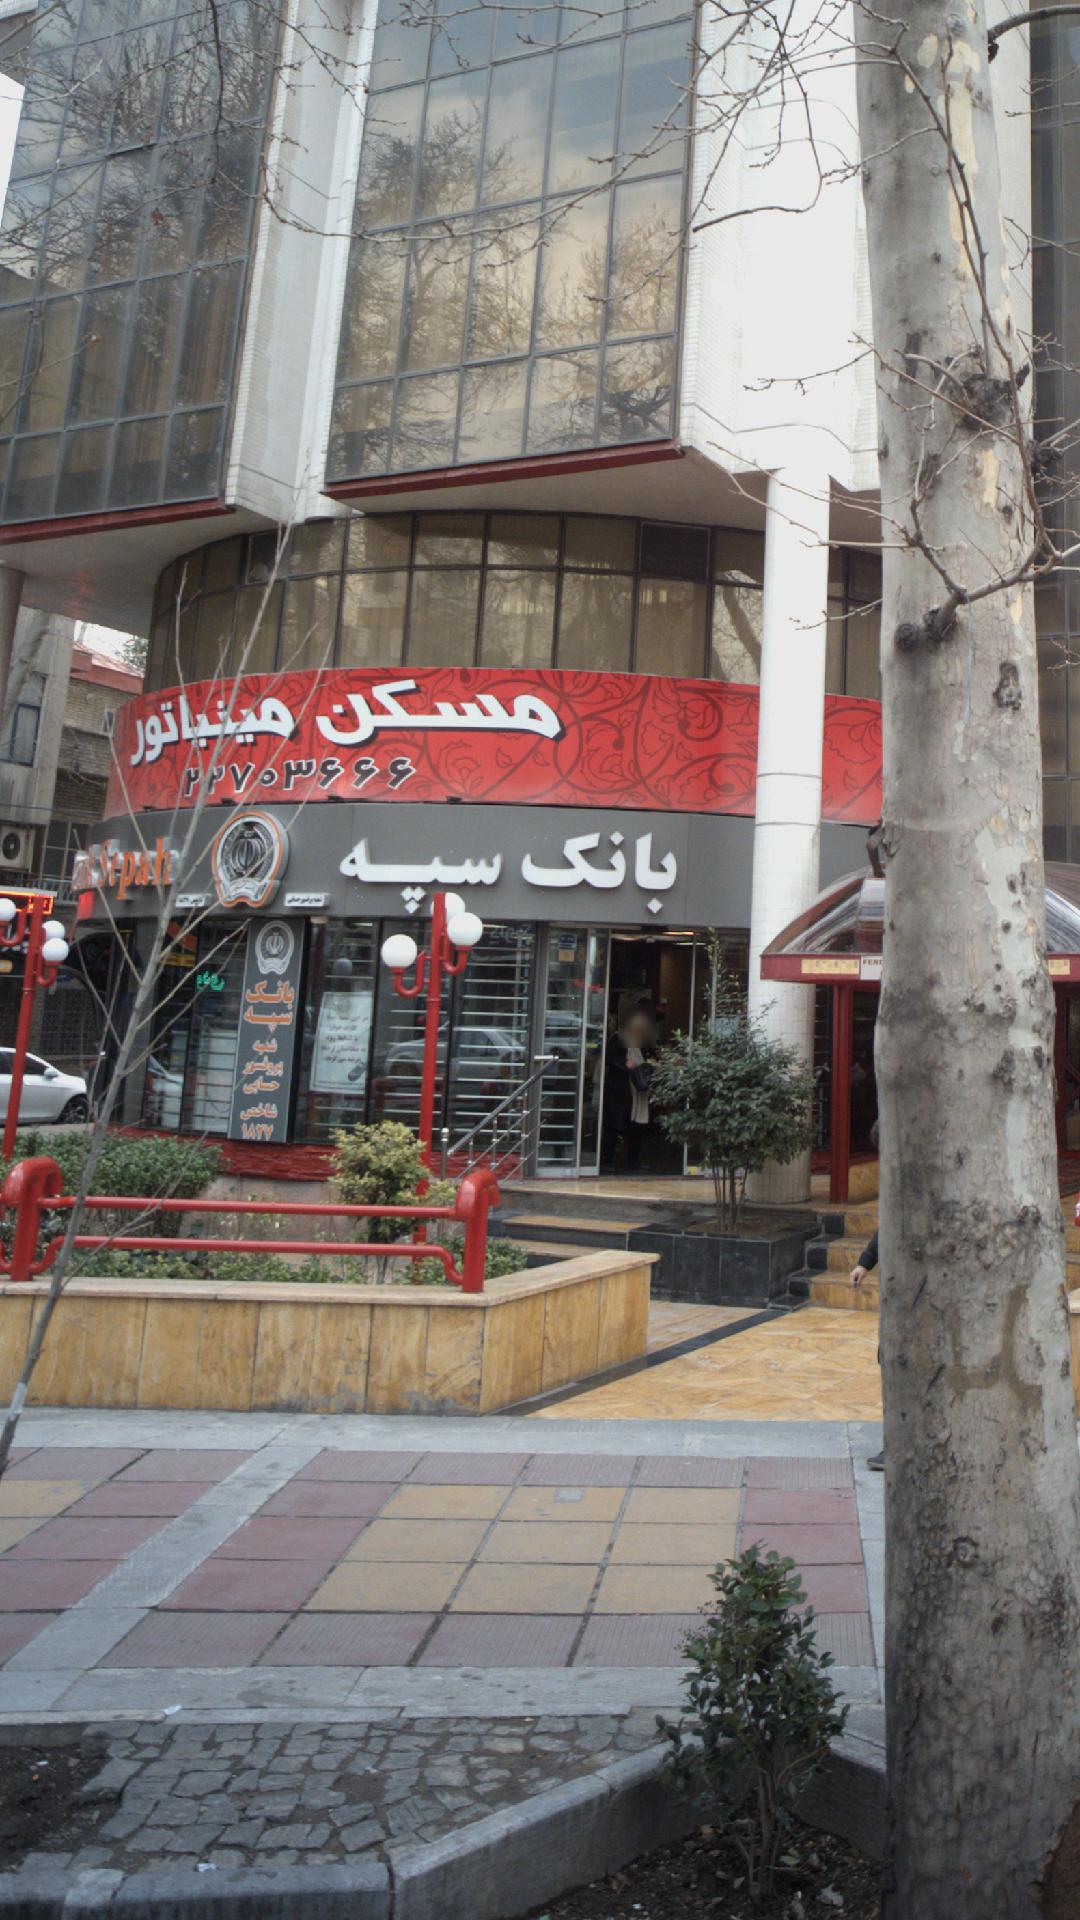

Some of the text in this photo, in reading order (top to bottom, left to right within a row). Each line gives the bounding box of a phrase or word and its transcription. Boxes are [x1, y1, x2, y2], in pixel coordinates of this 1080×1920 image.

[130, 679, 563, 767] مسکن مینیاتور
[96, 836, 174, 901] Sepah
[339, 831, 677, 914] بانک سپه
[245, 980, 295, 1010] بانک
[243, 1005, 293, 1033] سپه
[252, 1037, 278, 1055] شعبه
[242, 1075, 281, 1095] حسابی
